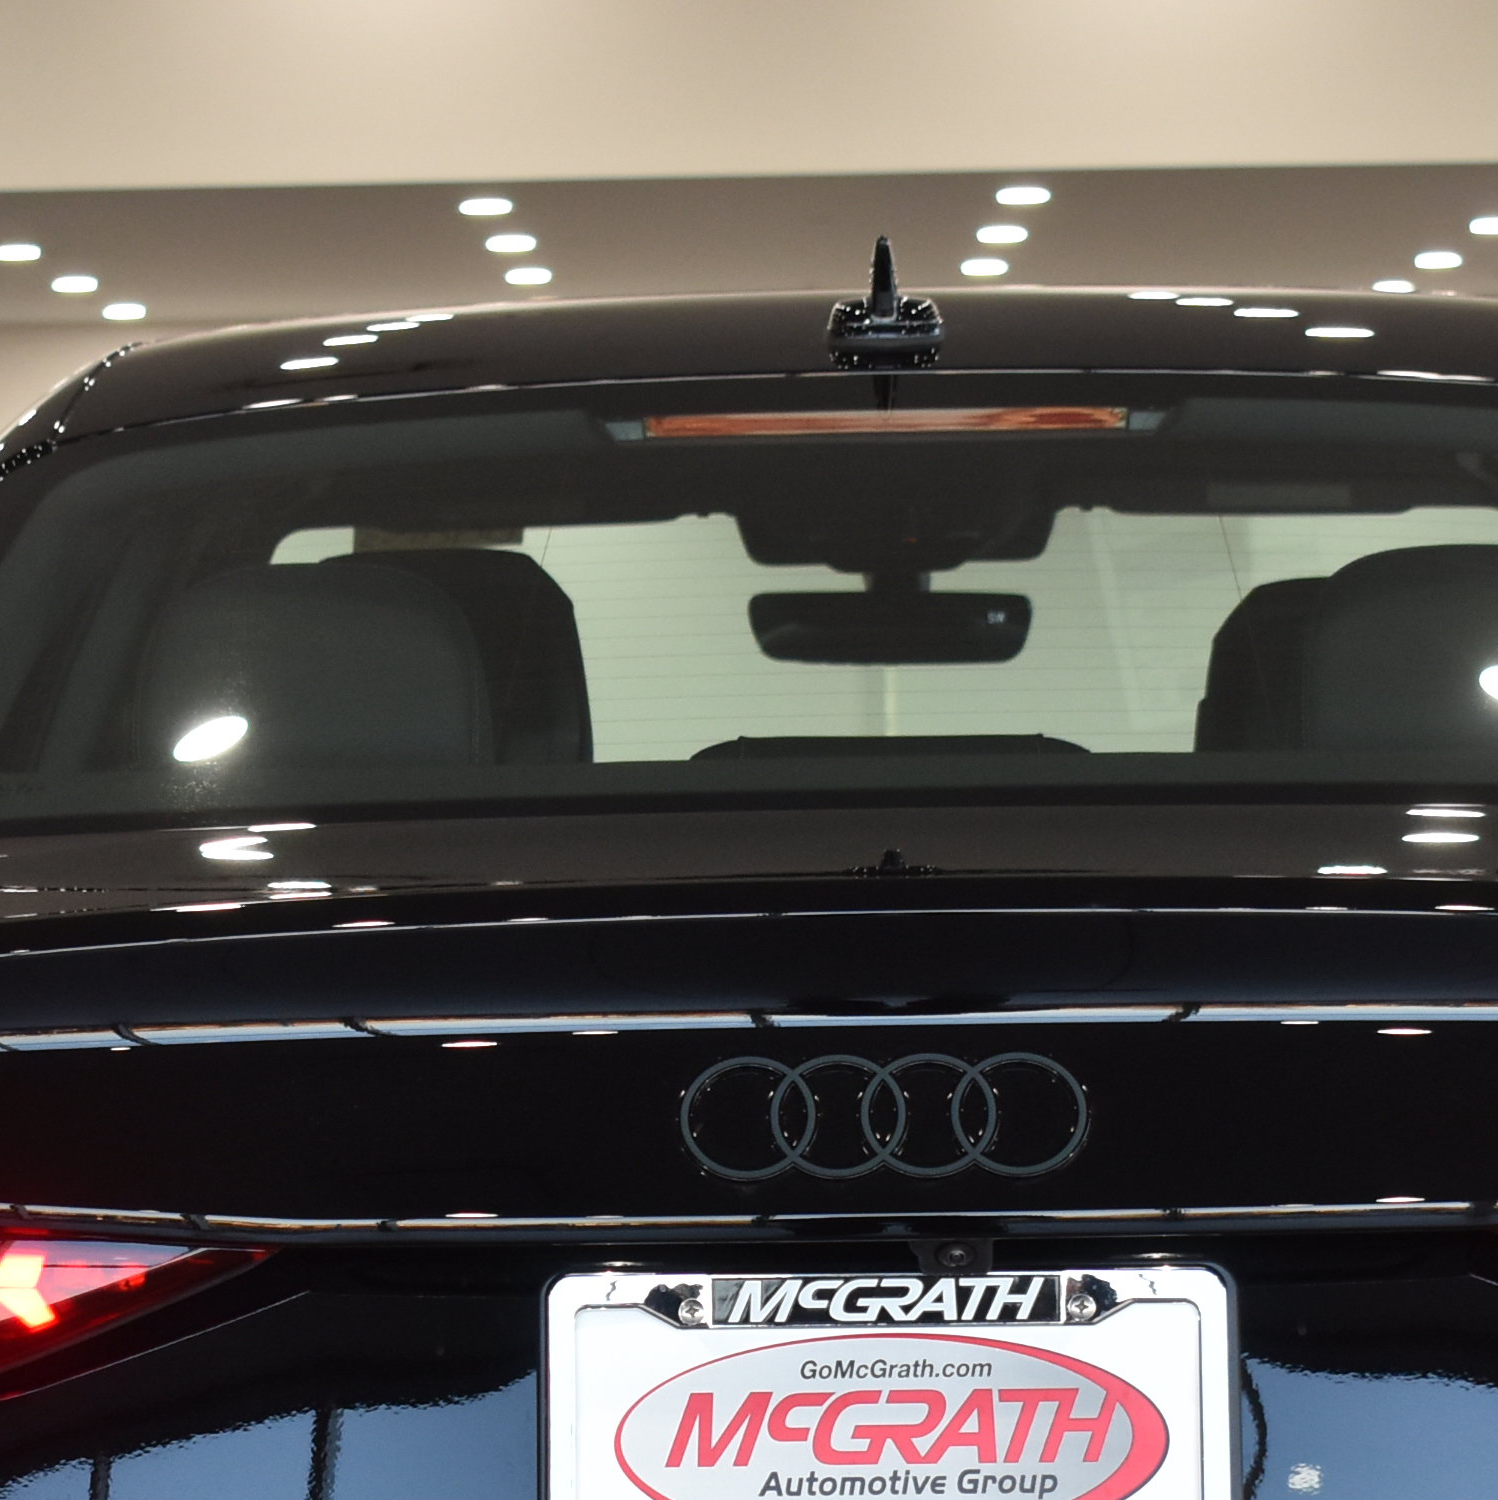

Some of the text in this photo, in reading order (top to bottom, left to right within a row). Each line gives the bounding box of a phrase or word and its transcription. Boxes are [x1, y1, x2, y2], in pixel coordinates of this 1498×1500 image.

[726, 1277, 1041, 1323] McGRATH
[800, 1358, 993, 1380] GoMcGrath.com
[665, 1387, 1116, 1468] McGRATH
[758, 1467, 1059, 1500] Automotive Group
